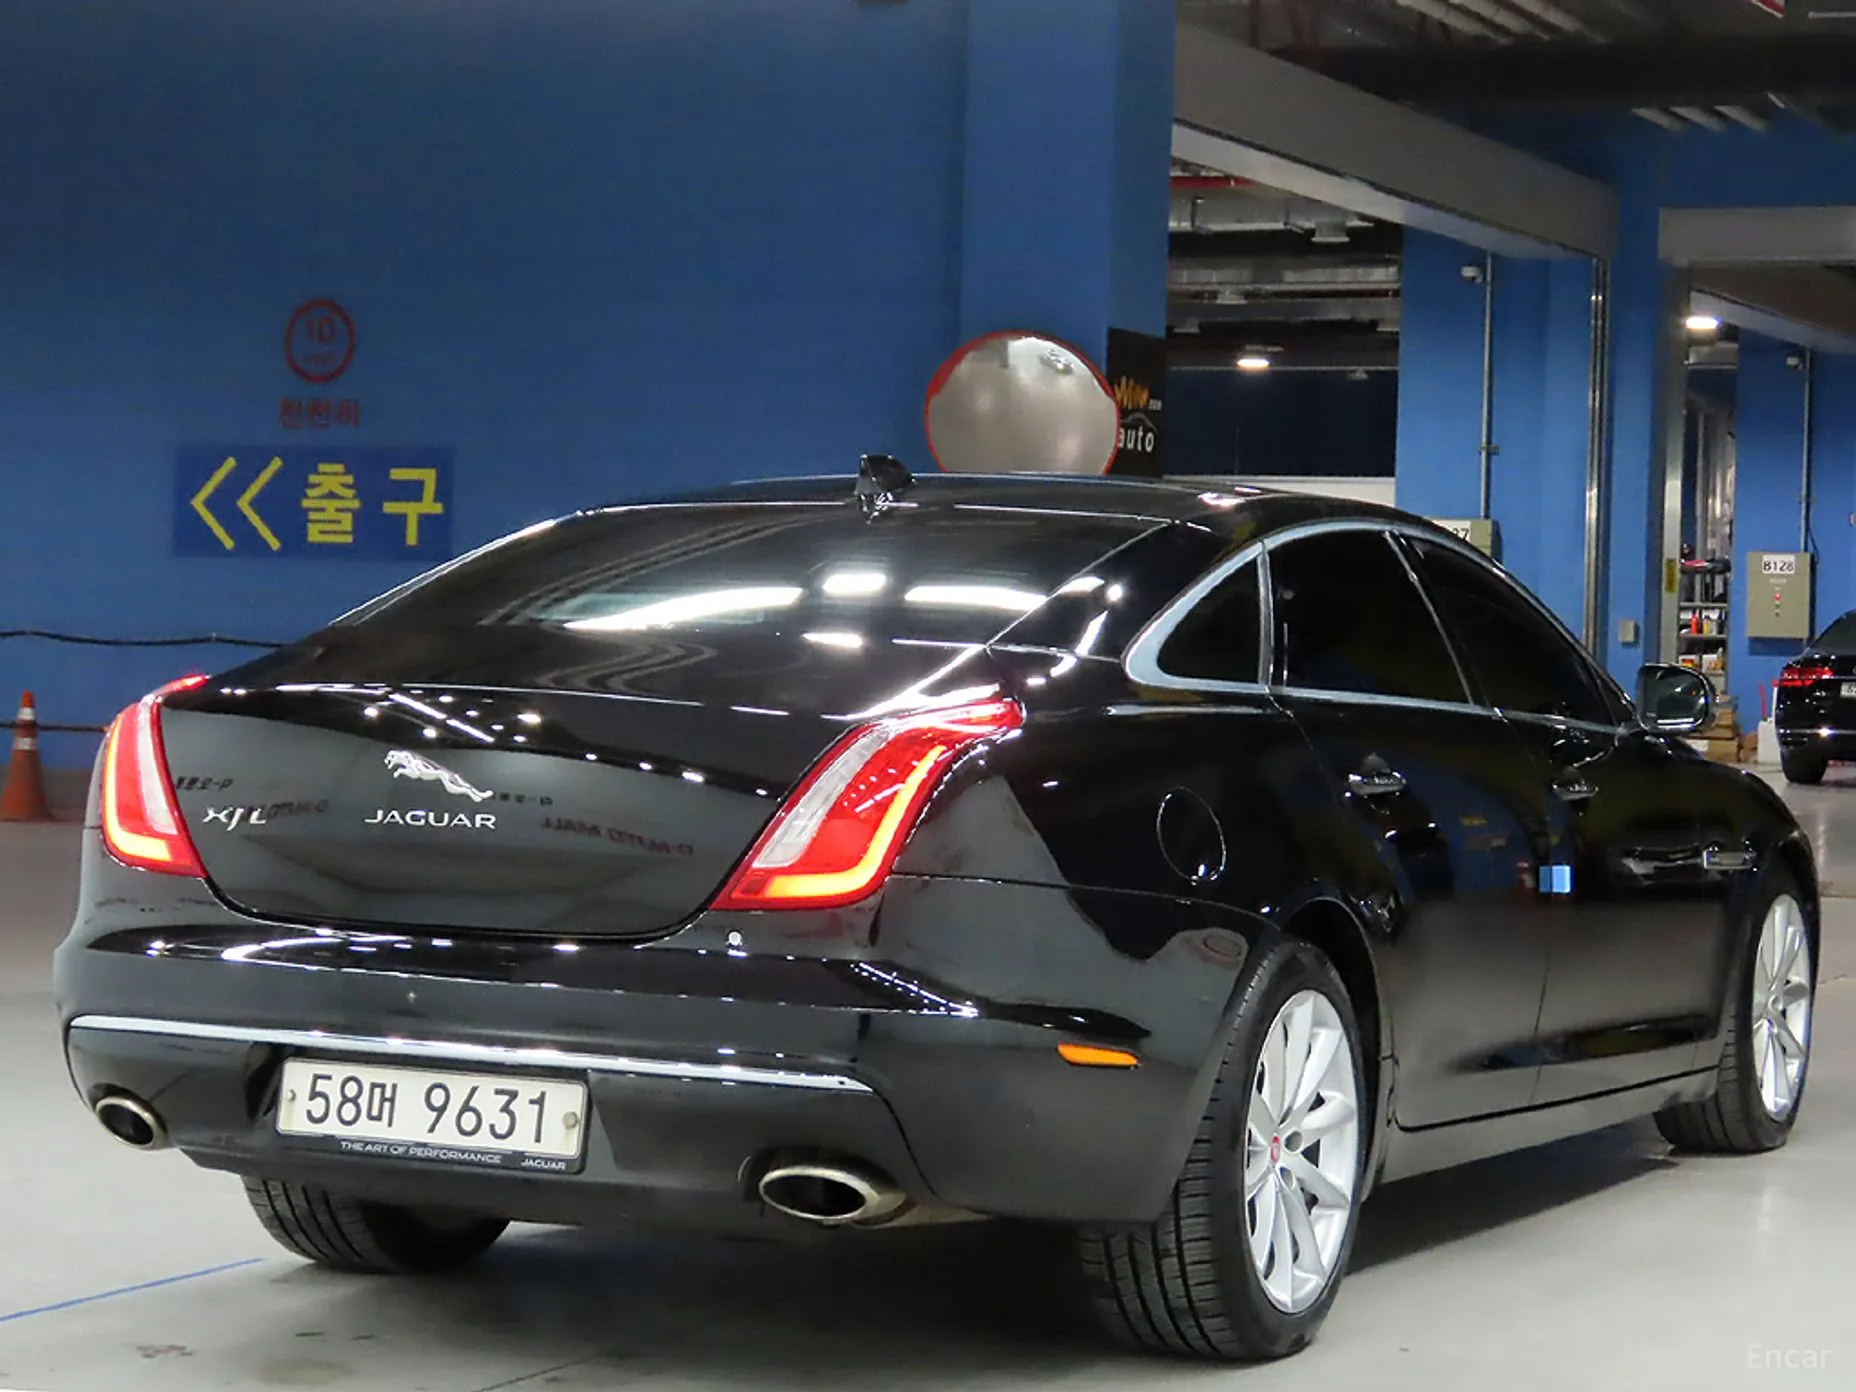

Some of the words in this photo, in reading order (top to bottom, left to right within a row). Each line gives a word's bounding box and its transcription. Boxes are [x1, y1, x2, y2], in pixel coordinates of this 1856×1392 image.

[305, 315, 336, 344] 10
[301, 463, 444, 546] 출구
[1763, 560, 1795, 572] B128
[202, 807, 267, 831] XJL
[364, 809, 497, 830] JAGUAR
[305, 1073, 398, 1128] 58머
[424, 1082, 547, 1144] 9631
[340, 1141, 364, 1151] THE
[364, 1143, 388, 1153] ART
[390, 1145, 407, 1155] OF
[409, 1147, 502, 1164] PERFORMANCE
[521, 1158, 567, 1171] JAGUAR
